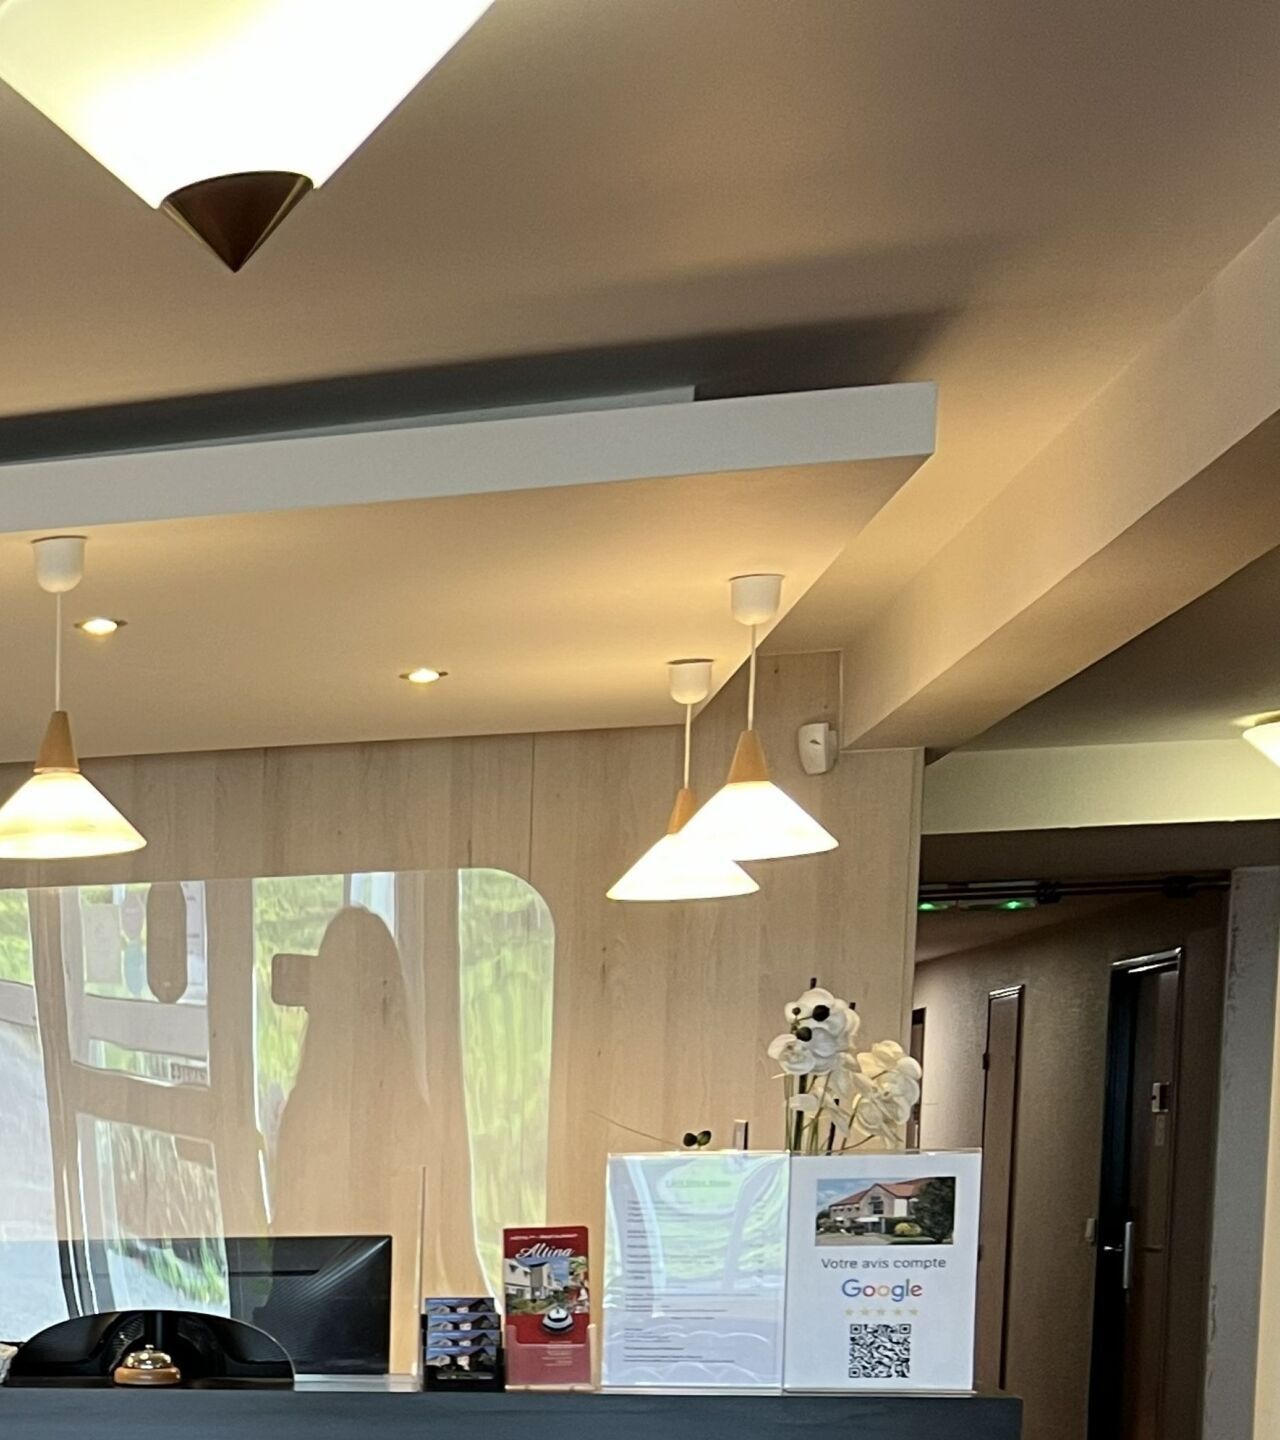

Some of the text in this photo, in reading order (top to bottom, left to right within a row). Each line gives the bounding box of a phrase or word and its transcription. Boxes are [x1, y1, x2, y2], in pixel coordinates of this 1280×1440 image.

[821, 1257, 946, 1270] Votre avis compte
[841, 1278, 923, 1302] Google
